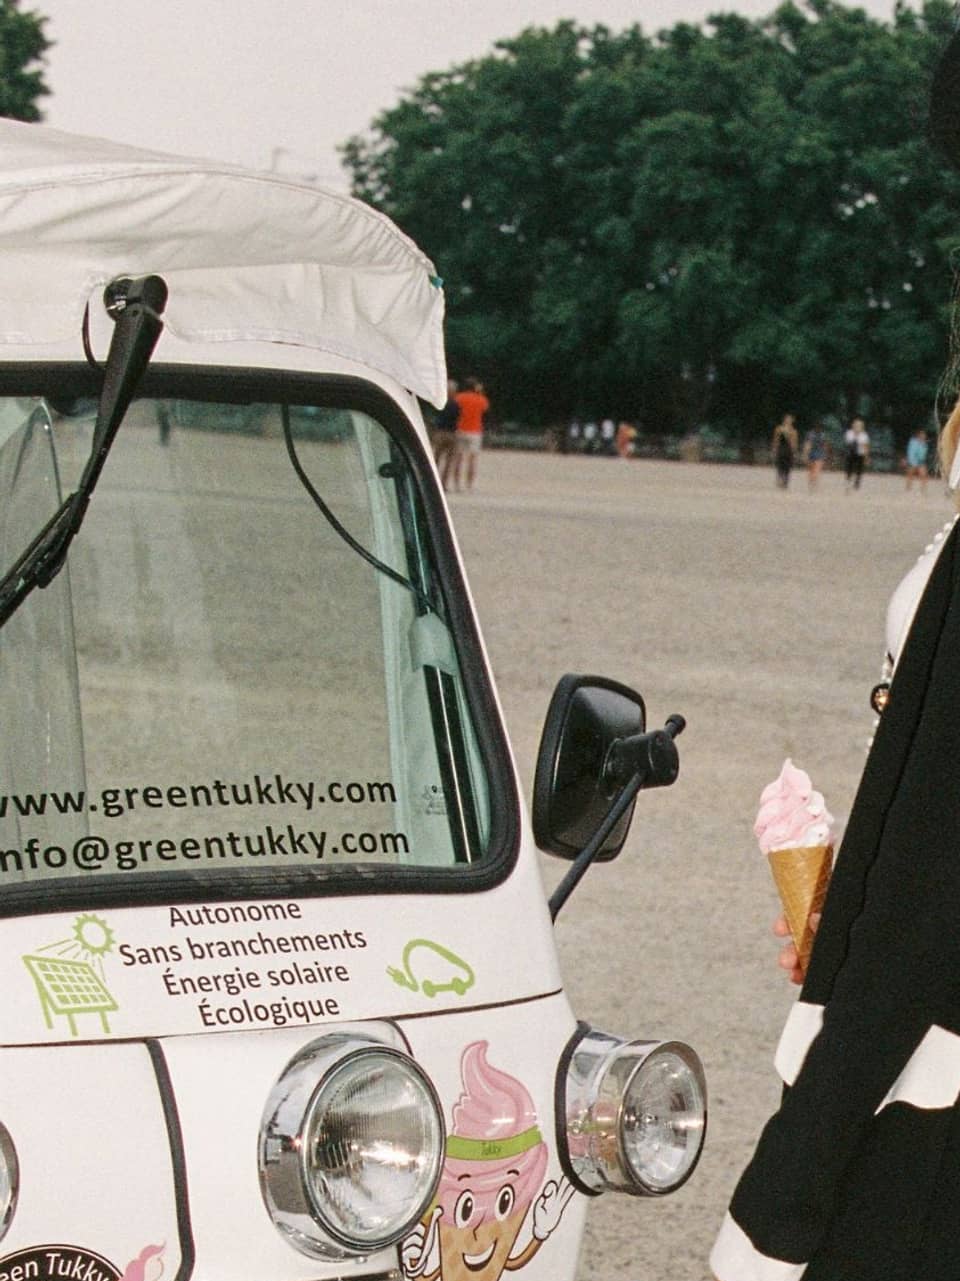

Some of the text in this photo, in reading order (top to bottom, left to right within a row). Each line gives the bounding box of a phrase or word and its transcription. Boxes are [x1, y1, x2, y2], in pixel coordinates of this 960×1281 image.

[0, 774, 397, 818] ww.greentukky.com
[170, 902, 302, 928] Autonome
[119, 929, 368, 966] Sans branchements
[162, 961, 350, 996] Énergie solaire
[198, 996, 340, 1026] Écologique
